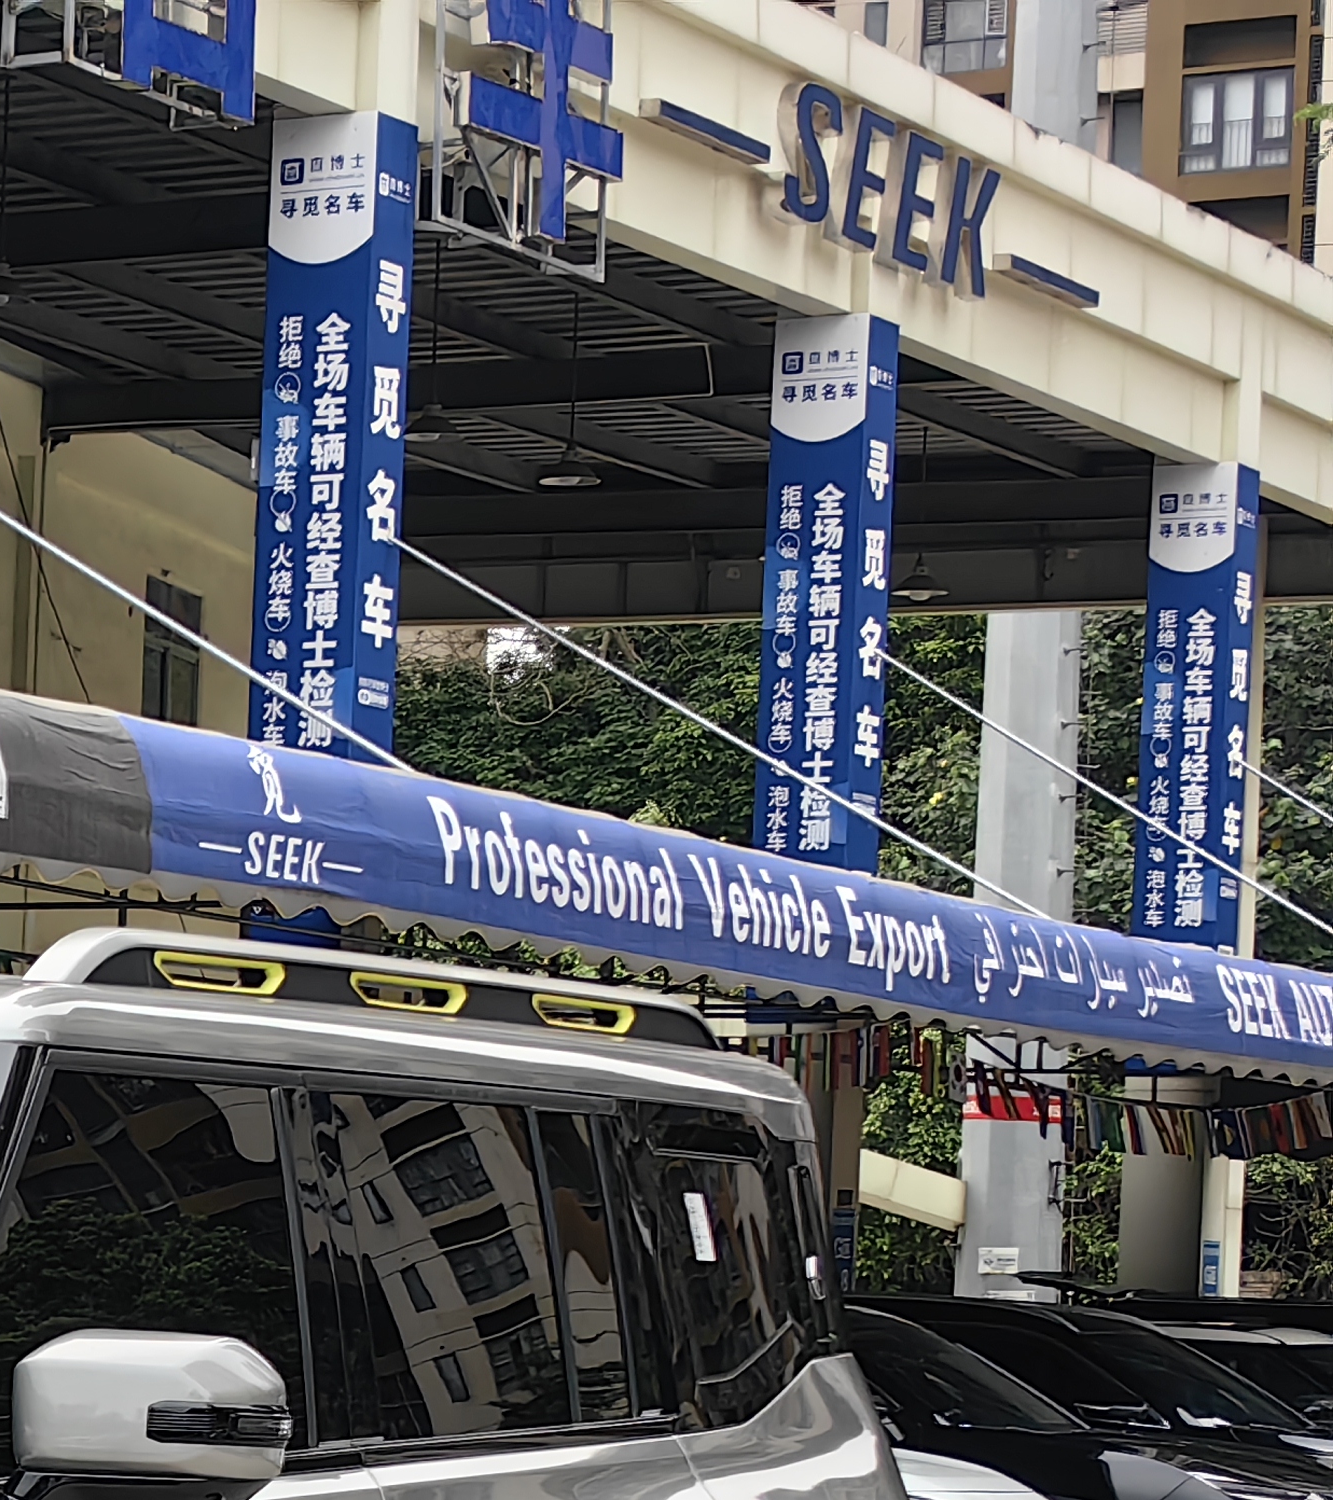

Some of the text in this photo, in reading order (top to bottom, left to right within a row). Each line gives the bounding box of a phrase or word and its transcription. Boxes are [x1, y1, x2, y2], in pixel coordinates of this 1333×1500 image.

[279, 192, 366, 219] 寻觅名车
[781, 82, 1001, 299] SEEK
[278, 315, 304, 369] 拒绝
[781, 381, 859, 403] 寻觅名车
[273, 415, 299, 494] 事故车
[361, 259, 406, 649] 寻觅名车
[267, 542, 294, 622] 火烧车
[297, 312, 351, 748] 全场车辆可经查博士检测
[764, 484, 804, 852] 拒绝 事故车 火烧车 泡水车
[798, 483, 846, 851] 全场车辆可经查博士检测
[854, 439, 889, 768] 寻觅名车
[244, 830, 325, 885] SEEK
[425, 795, 952, 992] Professional Vehicle Export
[1215, 963, 1292, 1040] SEEK
